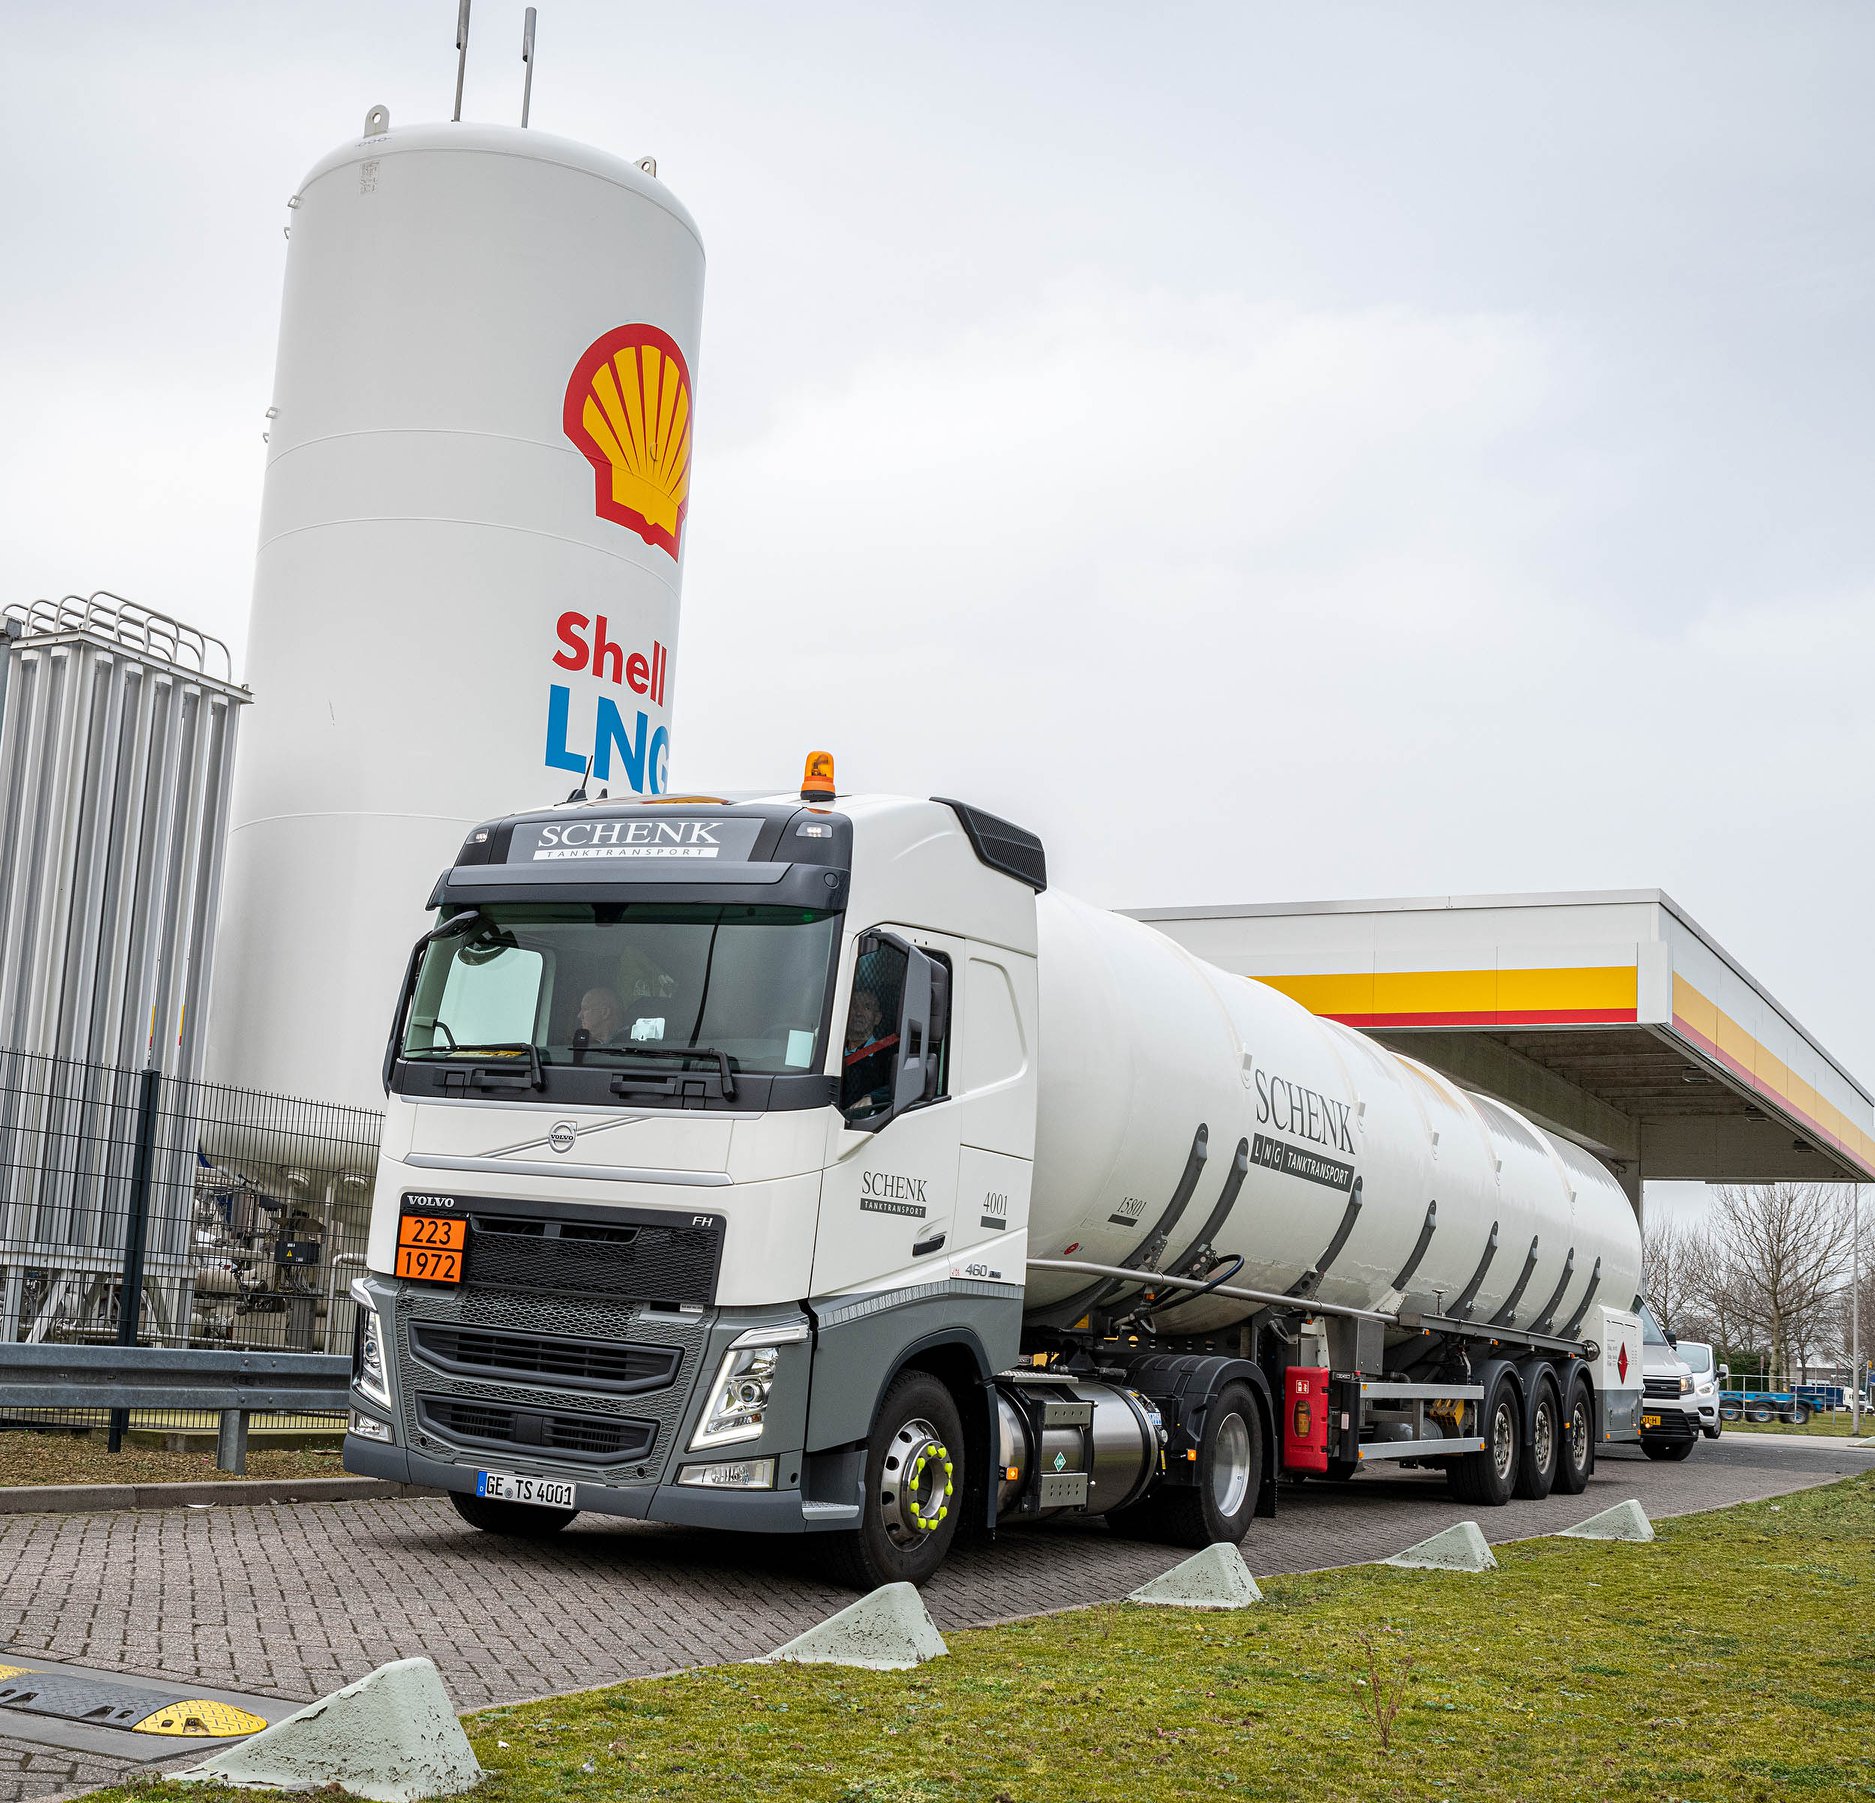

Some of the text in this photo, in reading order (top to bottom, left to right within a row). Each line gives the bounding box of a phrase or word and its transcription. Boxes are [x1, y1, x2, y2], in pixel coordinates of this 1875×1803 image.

[552, 611, 667, 707] Shell
[545, 684, 670, 795] LNG
[538, 822, 724, 847] SCHENK
[547, 848, 704, 858] TANKTRANSPORT
[1255, 1068, 1356, 1156] SCHENK
[1287, 1151, 1349, 1185] TANKTRANSPORT
[862, 1170, 928, 1202] SCHENK
[407, 1195, 455, 1208] VOLVO
[864, 1200, 923, 1216] TANKTRANSPORT
[983, 1192, 1008, 1216] 4001
[1117, 1197, 1147, 1217] 15801
[412, 1219, 450, 1245] 223
[692, 1216, 714, 1227] FH
[405, 1251, 456, 1279] 1972
[965, 1264, 988, 1277] 460
[486, 1476, 572, 1506] GE TS 4001
